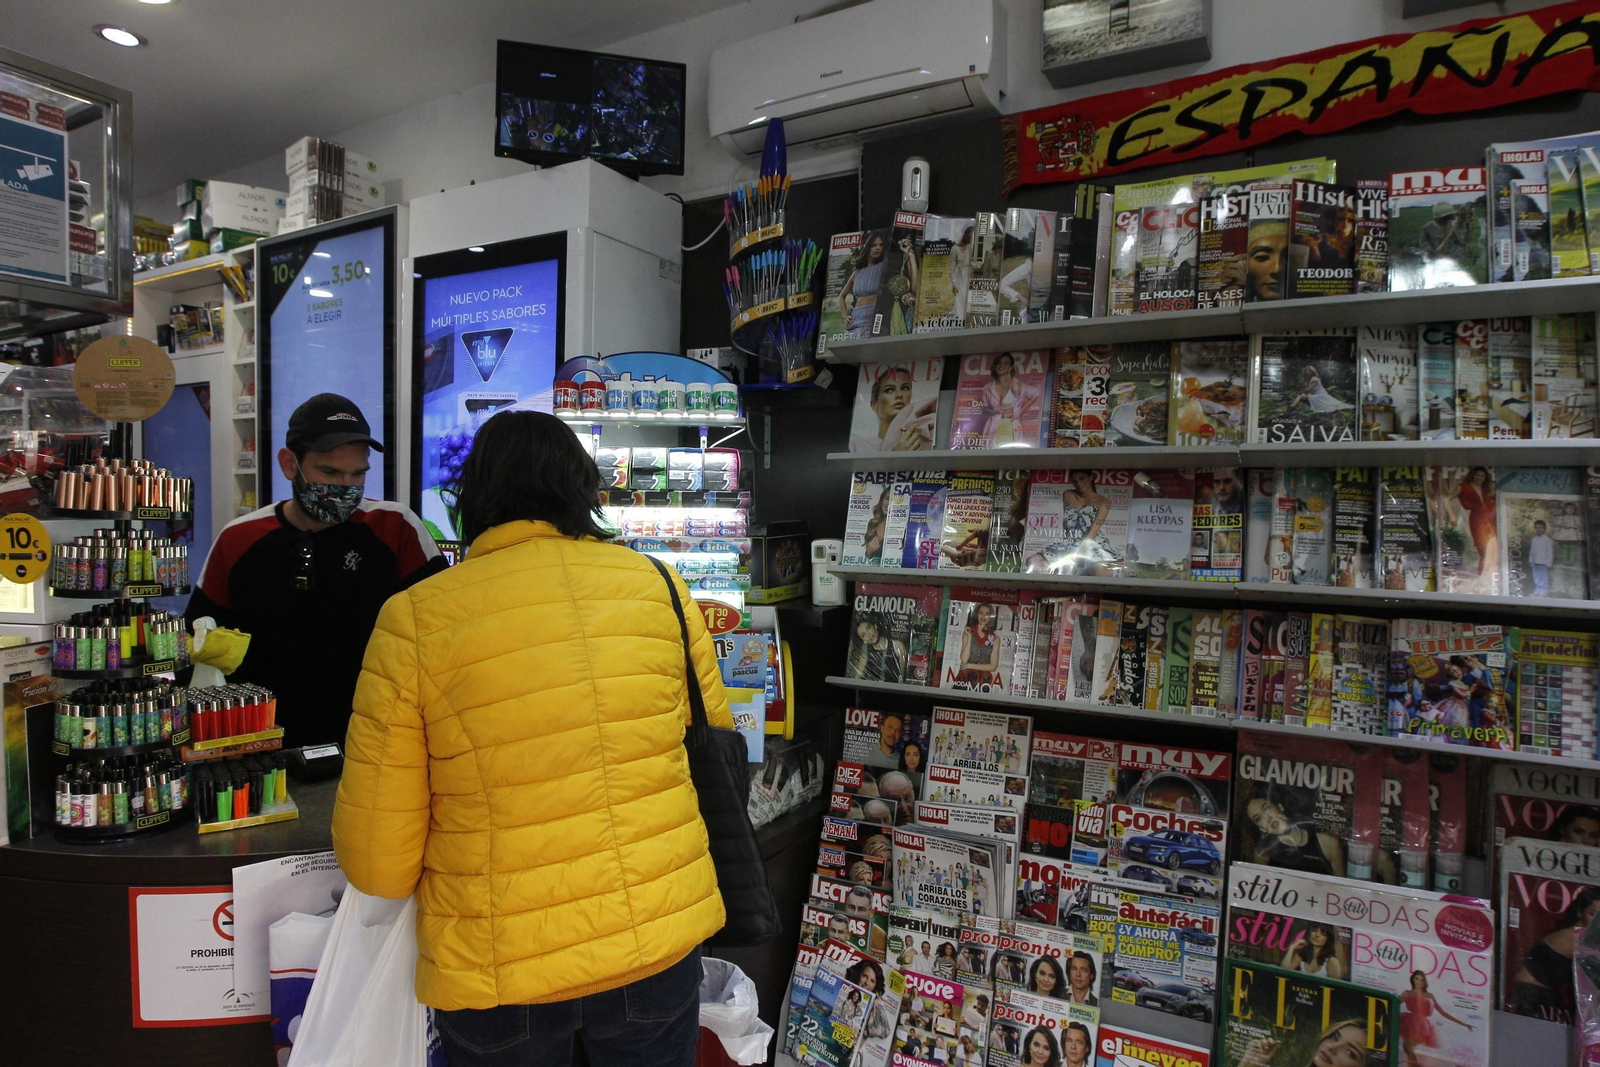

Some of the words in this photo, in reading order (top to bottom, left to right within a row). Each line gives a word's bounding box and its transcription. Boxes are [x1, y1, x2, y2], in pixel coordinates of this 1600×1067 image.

[820, 67, 844, 80] Hisense
[1502, 151, 1542, 163] ¡HOLA!
[1358, 189, 1387, 199] VIVE
[1391, 183, 1485, 198] HISTORIA
[896, 213, 926, 226] ¡HOLA!
[833, 235, 860, 246] ¡HOLA!
[331, 259, 365, 286] 3,50
[449, 289, 490, 305] NUEVO
[492, 285, 524, 300] PACK
[1140, 292, 1152, 300] EL
[1198, 292, 1212, 301] EL
[312, 298, 343, 311] SABORES
[314, 309, 342, 324] ELEGIR
[431, 312, 489, 328] MÚLTIPLES
[491, 303, 547, 321] SABORES
[477, 343, 496, 359] blu
[110, 359, 140, 367] CLIPPER
[862, 356, 940, 384] VOGUE
[963, 350, 1044, 377] CLRA
[140, 509, 169, 518] CLIPPER
[1149, 504, 1173, 515] LISA
[1137, 514, 1184, 526] KLEYPAS
[700, 540, 731, 552] Orbit
[129, 586, 160, 596] CLIPPER
[699, 578, 730, 589] Orbit
[970, 590, 1006, 598] MASCARILLA
[855, 595, 916, 615] GLAMOUR
[1411, 636, 1504, 656] QUIZ
[146, 663, 172, 673] CLIPPER
[732, 669, 758, 678] pascua
[1351, 673, 1363, 681] 64
[1336, 691, 1378, 704] CRUZADAS
[845, 708, 880, 728] LOVE
[936, 710, 965, 724] ¡HOLA!
[1033, 738, 1085, 755] muy
[953, 758, 982, 770] ARRIBA
[984, 762, 1000, 772] LOS
[1122, 744, 1227, 776] muy
[837, 766, 861, 780] DIEZ
[931, 766, 960, 780] ¡HOLA!
[1239, 755, 1355, 796] GLAMOUR
[836, 777, 860, 787] MINUTOS
[831, 802, 850, 811] MINUTOS
[832, 794, 850, 805] DIEZ
[919, 805, 948, 821] ¡HOLA!
[1080, 804, 1104, 818] Auto
[1312, 812, 1347, 823] CANCIÓN
[1321, 808, 1338, 816] ESTA
[139, 813, 168, 828] CLIPPER
[1111, 805, 1224, 842] Coches
[823, 817, 858, 841] SEMANA
[895, 834, 924, 848] ¡HOLA!
[818, 847, 846, 866] SEMANA
[1108, 846, 1120, 857] A3
[295, 859, 310, 869] POR
[811, 876, 893, 914] LECTAS
[918, 883, 948, 897] ARRIBA
[950, 887, 967, 899] LOS
[918, 893, 968, 909] CORAZONES
[1233, 875, 1299, 908] stilo
[1326, 892, 1430, 934] BODAS
[1342, 899, 1369, 917] stilo
[802, 905, 866, 938] LECTAS
[1119, 902, 1213, 934] autofácil
[1089, 920, 1116, 933] ROC
[1118, 924, 1134, 937] ¿Y
[1135, 927, 1177, 942] AHORA
[1444, 922, 1477, 938] NOVIAS
[1073, 936, 1097, 948] ESPECIAL
[1118, 935, 1135, 945] QUE
[1136, 937, 1165, 948] COCHE
[1167, 941, 1180, 950] ME
[1440, 929, 1486, 948] INVITADAS
[998, 936, 1062, 960] pronto
[1117, 942, 1182, 963] COMPRO?
[1188, 943, 1203, 951] AUDI
[1204, 945, 1214, 953] A3
[1373, 944, 1409, 964] stilo
[1354, 933, 1488, 988] BODAS
[793, 975, 813, 989] mia
[817, 968, 838, 986] mia
[905, 975, 955, 1000] cuore
[993, 1004, 1057, 1030] pronto
[1069, 1006, 1093, 1018] ESPECIAL
[1229, 966, 1390, 1053] ELLE
[800, 1014, 819, 1037] 22
[1101, 1037, 1122, 1055] el
